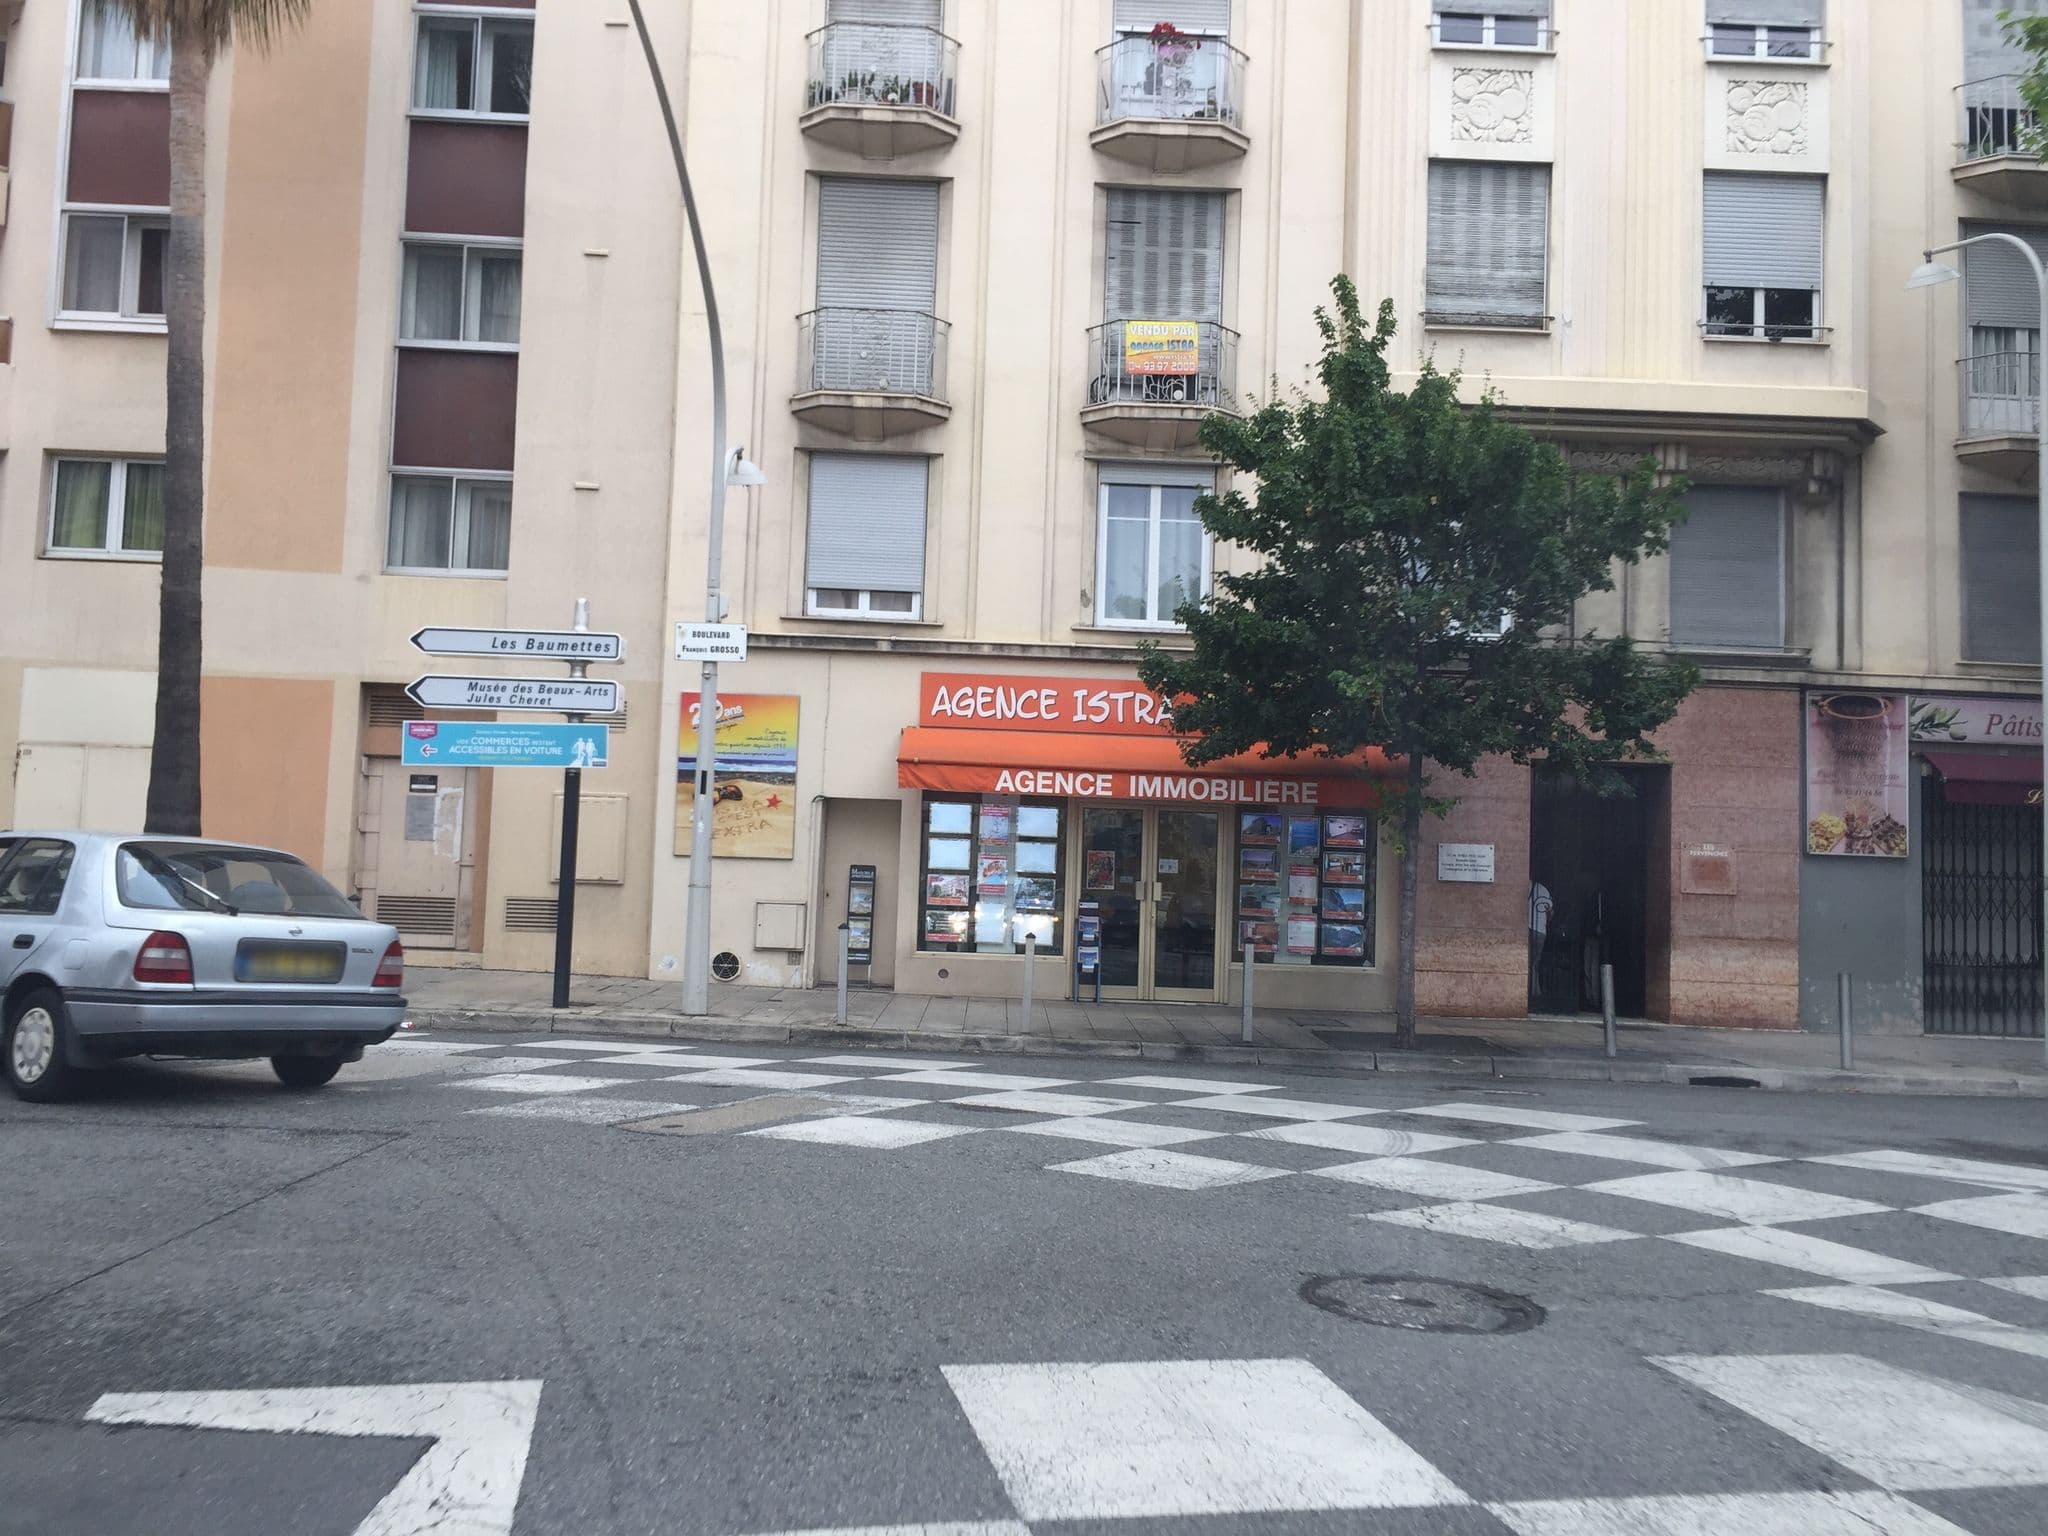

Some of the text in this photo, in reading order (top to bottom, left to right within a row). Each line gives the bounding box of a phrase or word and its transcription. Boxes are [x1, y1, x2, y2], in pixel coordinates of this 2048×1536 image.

[1130, 325, 1195, 337] VENDU PAR
[691, 630, 731, 639] BOULEVARD
[492, 637, 612, 653] Les Baumettes
[710, 645, 740, 654] GROSSO
[467, 682, 507, 693] Musée
[512, 683, 533, 694] des
[466, 693, 552, 706] Jules Cheret
[930, 685, 1060, 720] AGENCE
[470, 736, 530, 747] COMMERCES
[448, 744, 563, 756] ACCESSIBLES EN VOITURE
[994, 769, 1319, 805] AGENCE IMMOBILIÈRE
